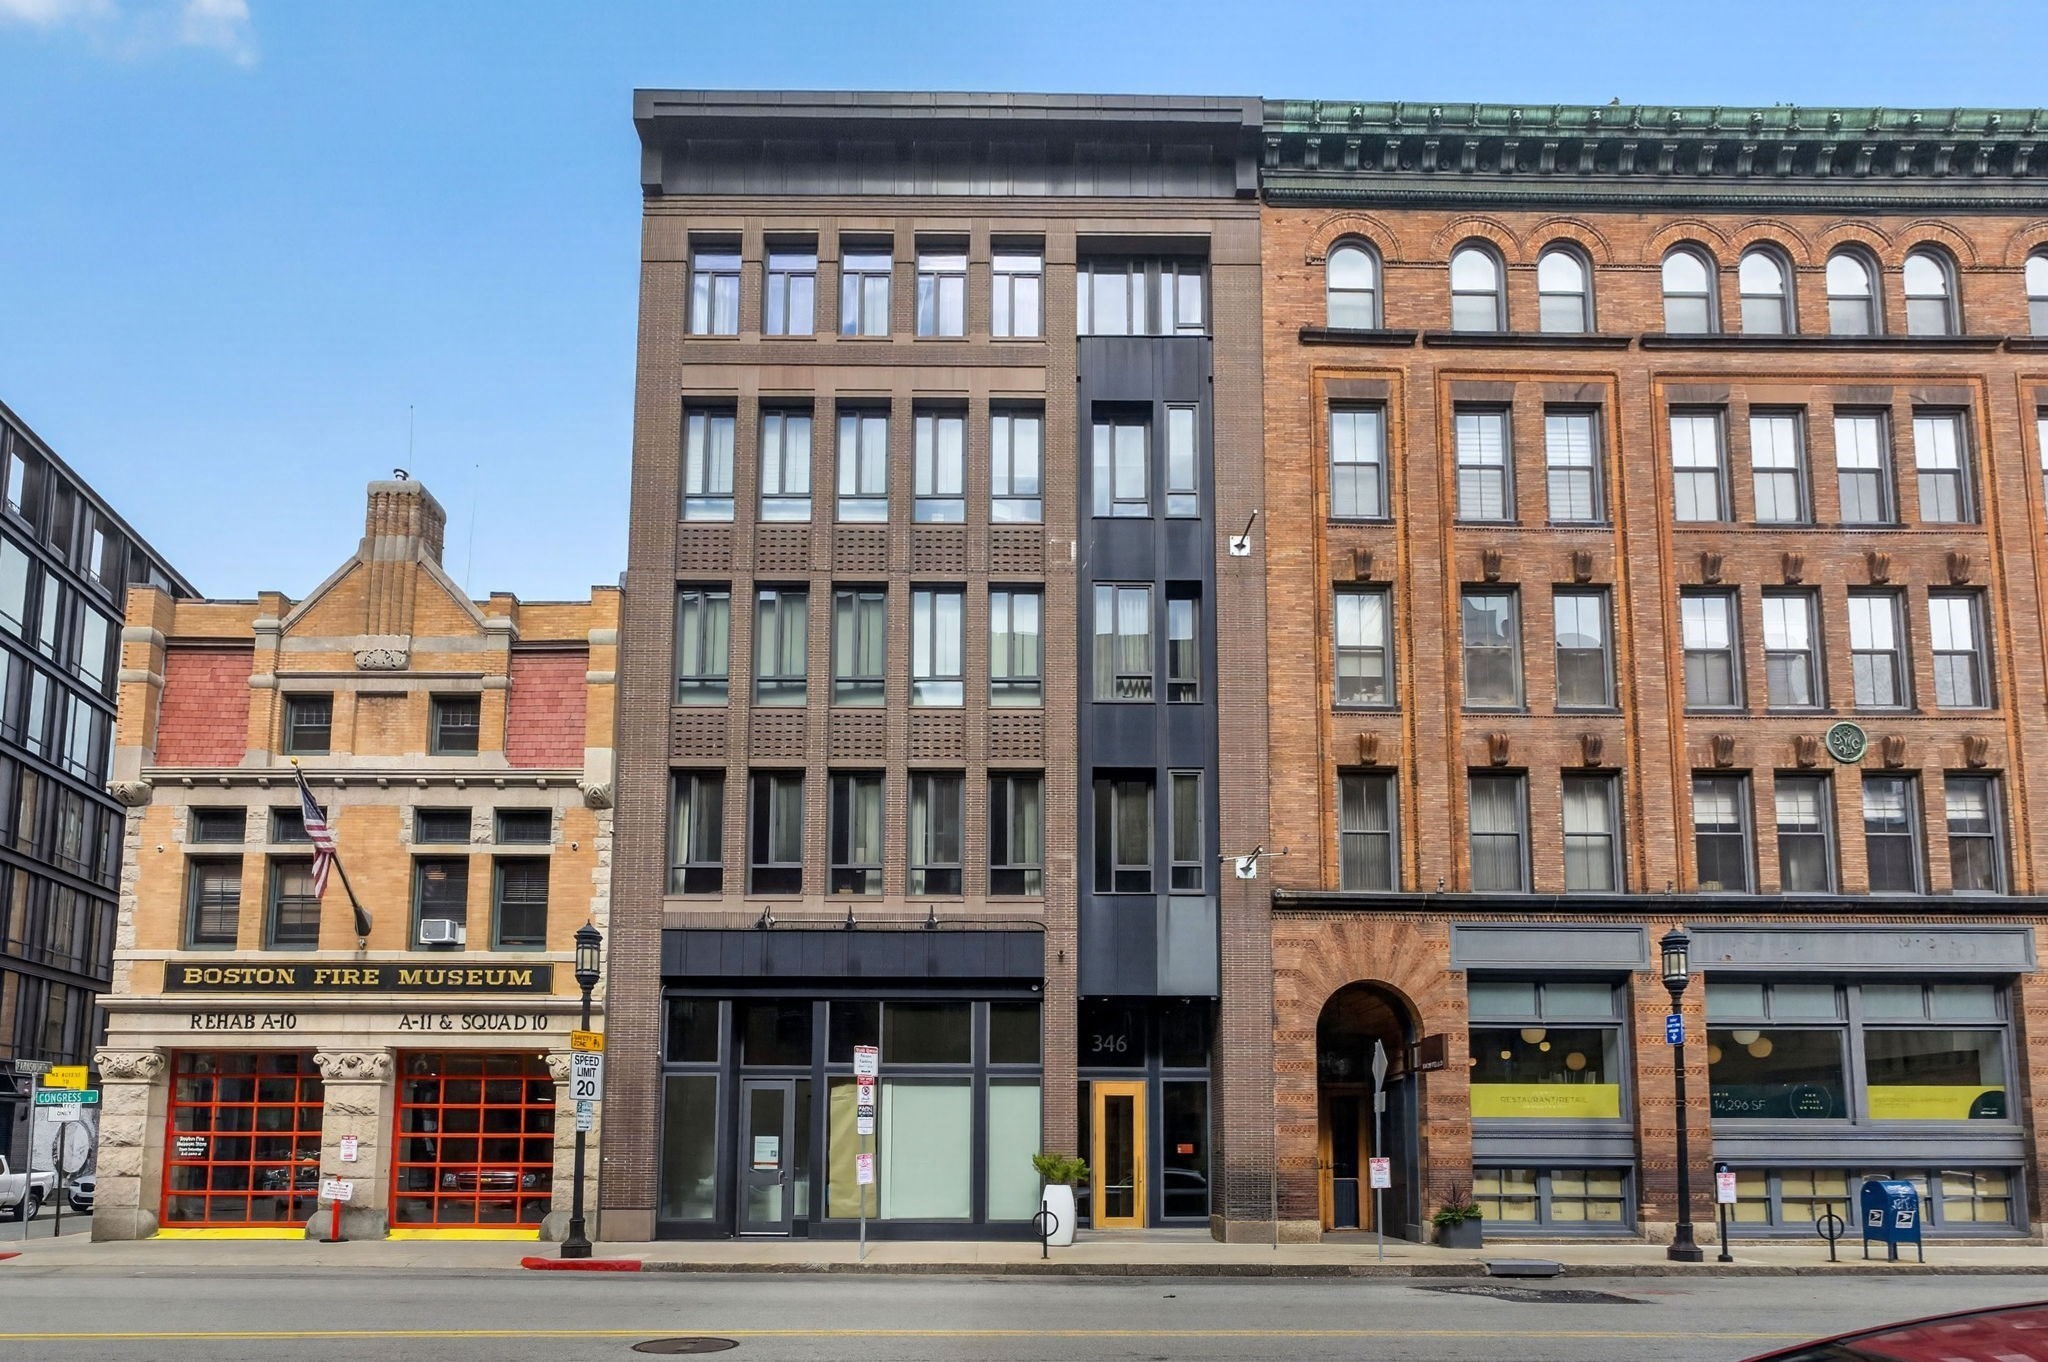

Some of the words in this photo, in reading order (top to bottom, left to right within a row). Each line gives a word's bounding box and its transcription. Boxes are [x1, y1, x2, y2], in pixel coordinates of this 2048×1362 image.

[183, 968, 295, 985] BOSTON
[314, 968, 380, 985] FIRE
[398, 969, 532, 986] MUSEUM
[190, 1013, 255, 1030] REHAB
[261, 1013, 297, 1030] A-10
[398, 1014, 432, 1031] A-11
[439, 1014, 452, 1031] &
[461, 1014, 527, 1031] SQUAD
[532, 1014, 548, 1031] 10
[1091, 1034, 1128, 1052] 346
[574, 1054, 600, 1067] SPEED
[577, 1066, 596, 1078] LIMIT
[576, 1079, 595, 1097] 20
[39, 1092, 82, 1103] CONGRESS
[1500, 1096, 1589, 1104] RESTAURANT/RETAIL
[1714, 1099, 1750, 1111] 14,296
[1751, 1099, 1766, 1111] SF
